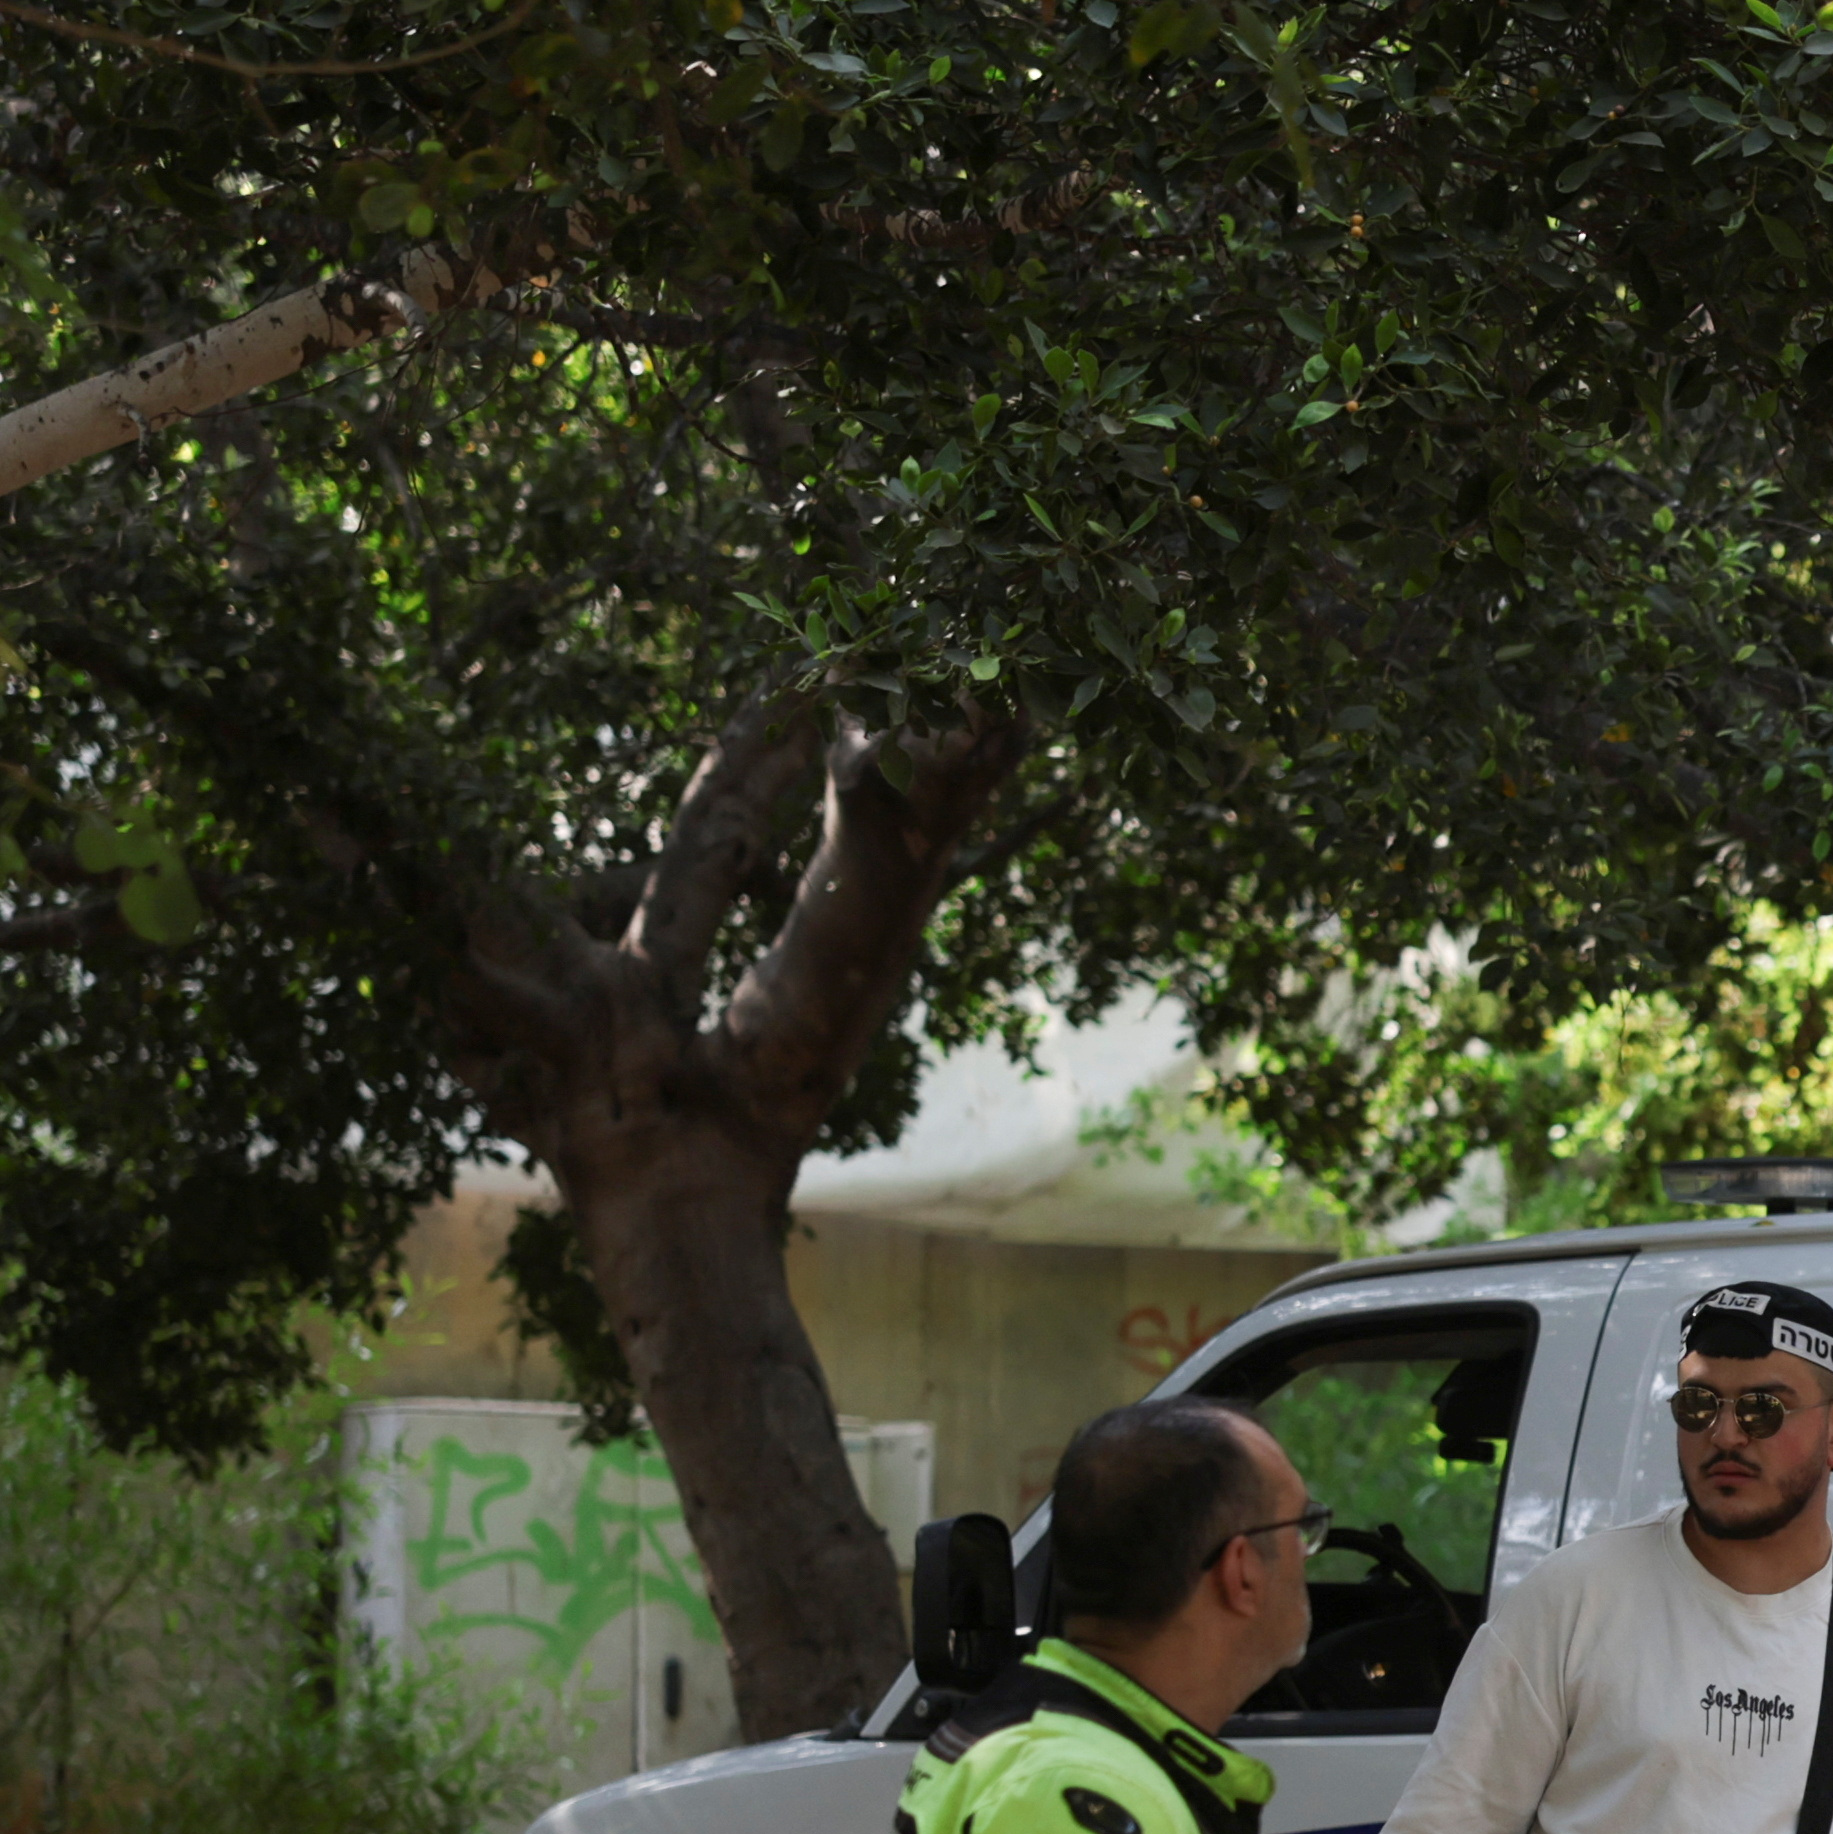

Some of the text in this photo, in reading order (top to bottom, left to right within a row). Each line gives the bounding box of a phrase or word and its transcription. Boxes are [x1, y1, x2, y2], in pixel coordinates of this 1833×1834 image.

[1709, 1292, 1760, 1309] LICE
[1700, 1684, 1794, 1722] Los Angeles
